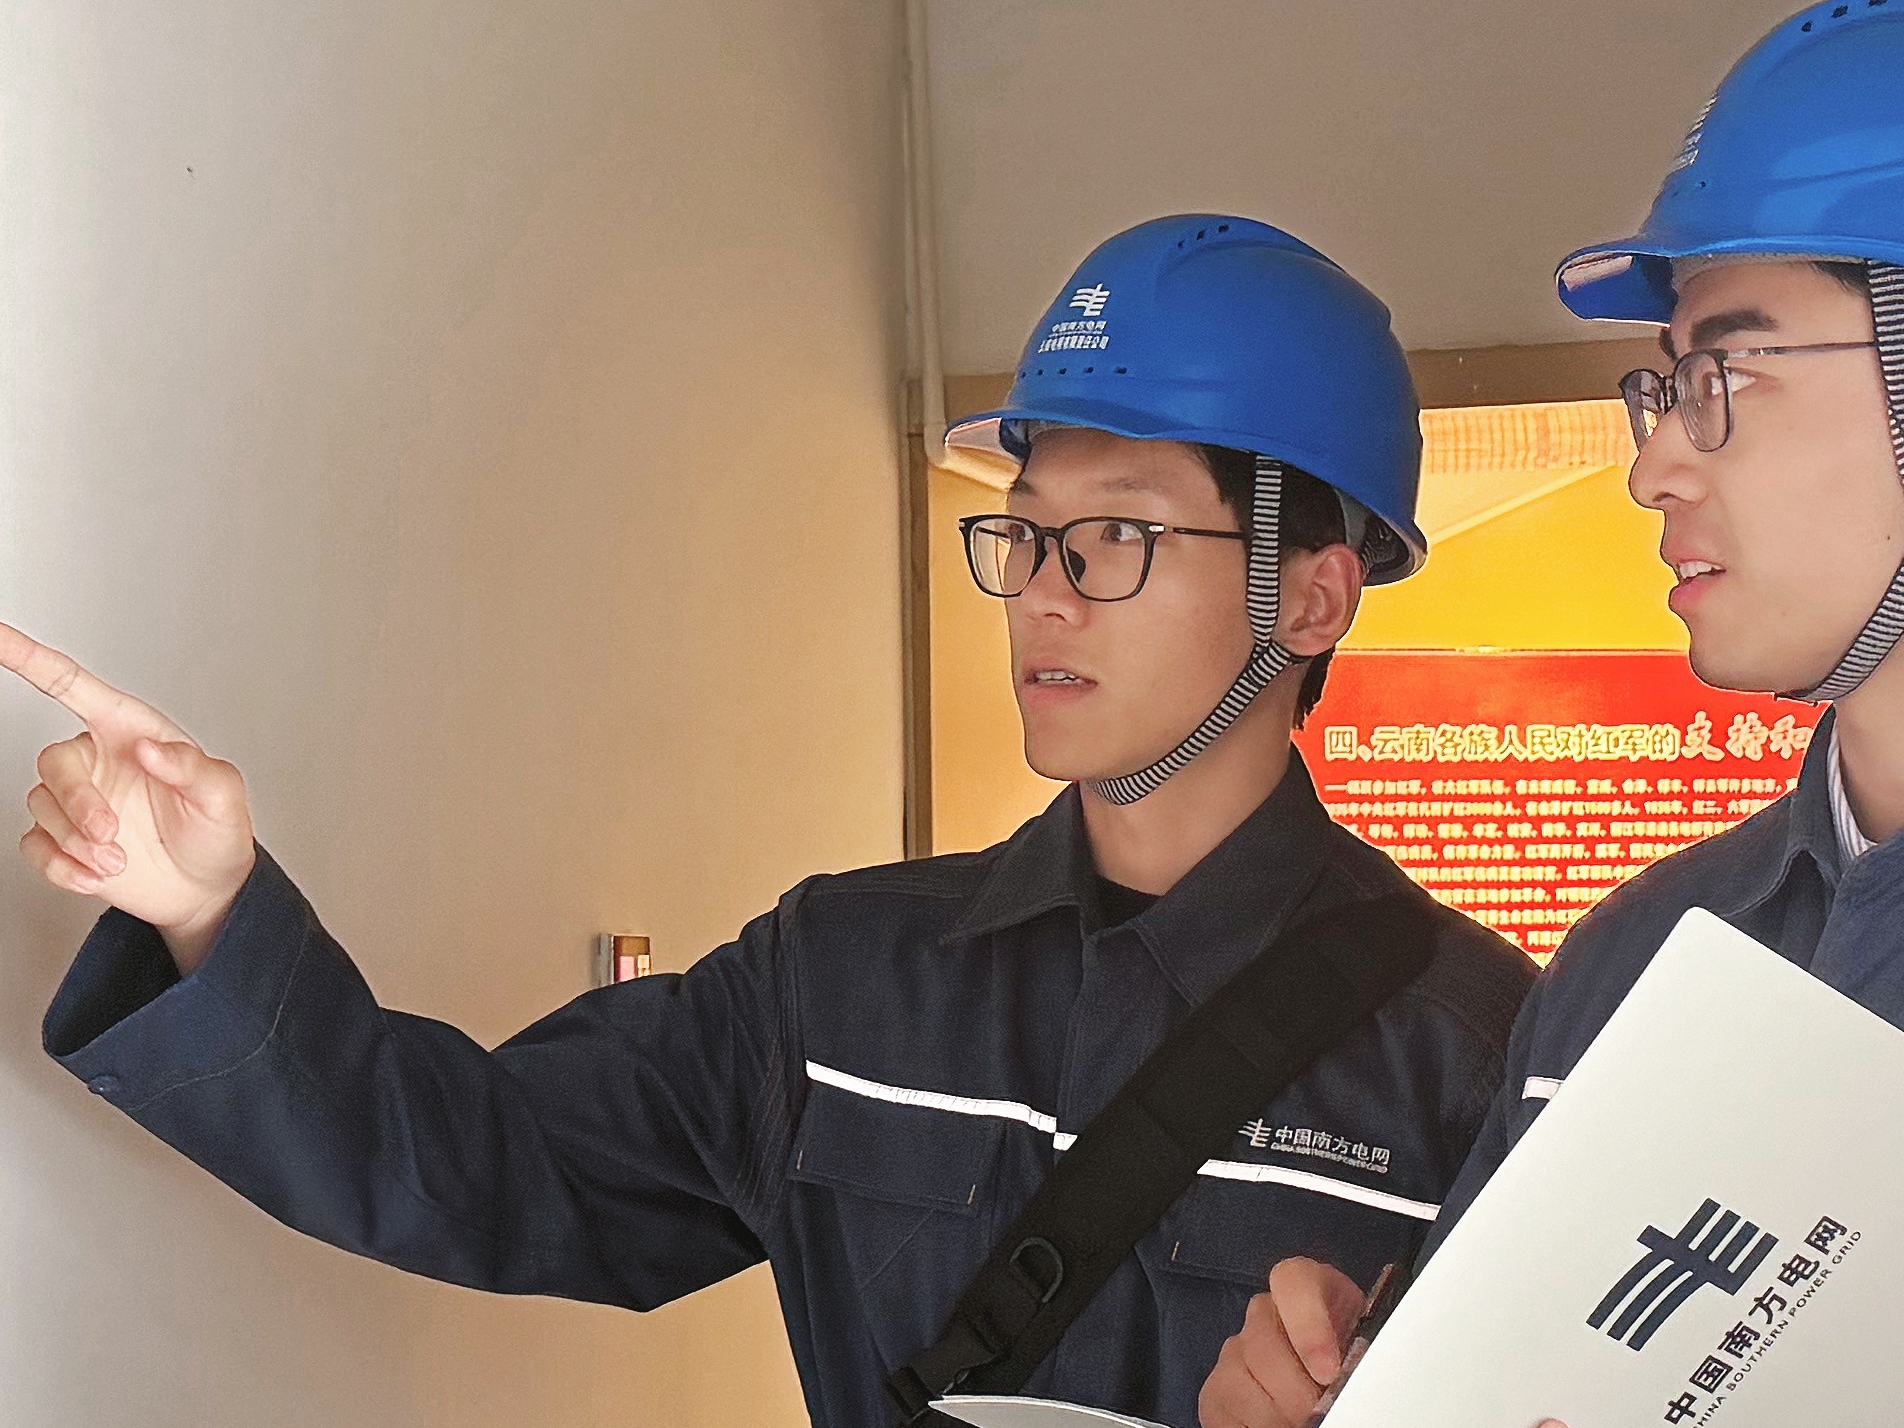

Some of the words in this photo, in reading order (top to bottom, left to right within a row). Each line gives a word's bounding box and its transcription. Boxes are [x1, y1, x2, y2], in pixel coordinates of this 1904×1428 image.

[1275, 1125, 1391, 1165] 中国南方电网
[1664, 1215, 1848, 1425] 中国南方电网
[1726, 1320, 1789, 1392] SOUTHERN
[1788, 1268, 1833, 1317] POWER
[1832, 1231, 1862, 1265] GRID
